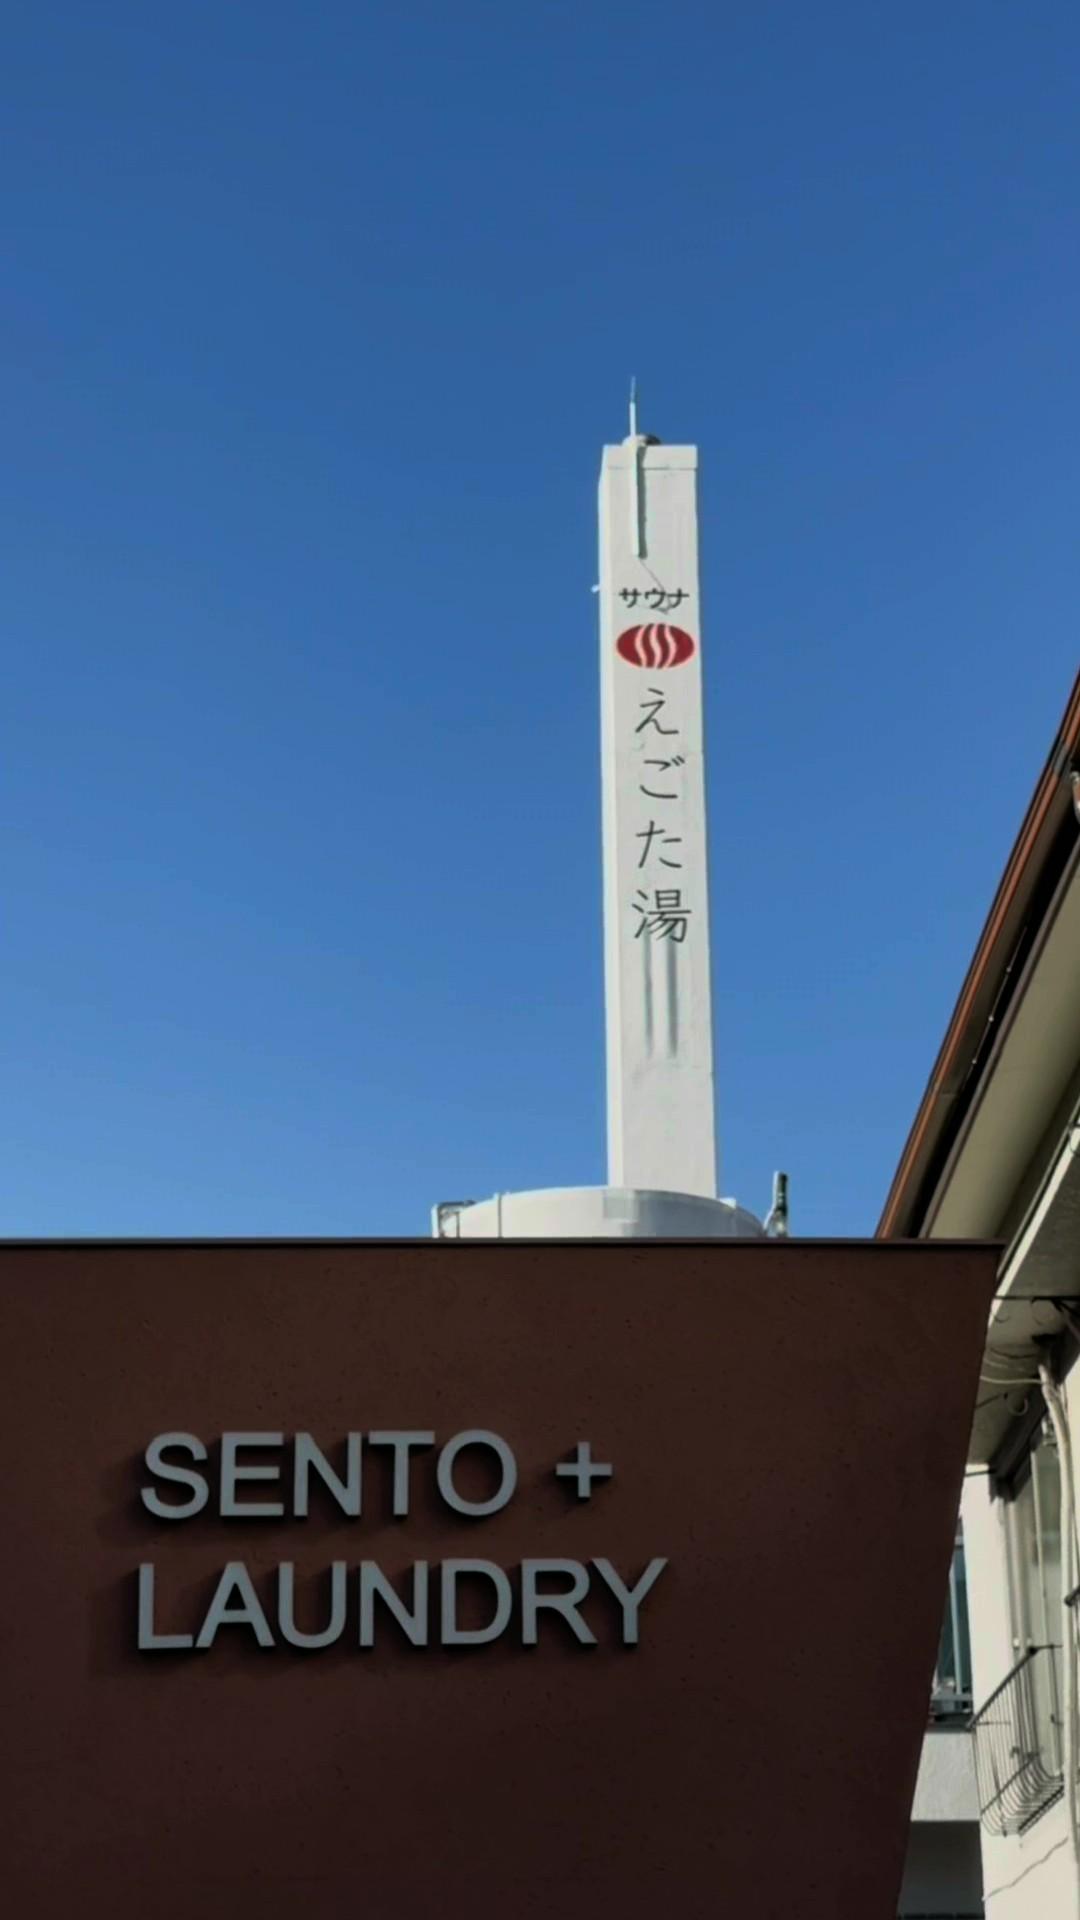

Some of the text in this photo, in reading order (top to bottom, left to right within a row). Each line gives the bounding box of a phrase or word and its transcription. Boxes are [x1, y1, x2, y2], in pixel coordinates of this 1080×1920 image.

[618, 588, 690, 609] サウナ
[631, 687, 692, 943] えごた湯
[140, 1429, 613, 1519] SENTO +
[138, 1557, 669, 1650] LAUNDRY
